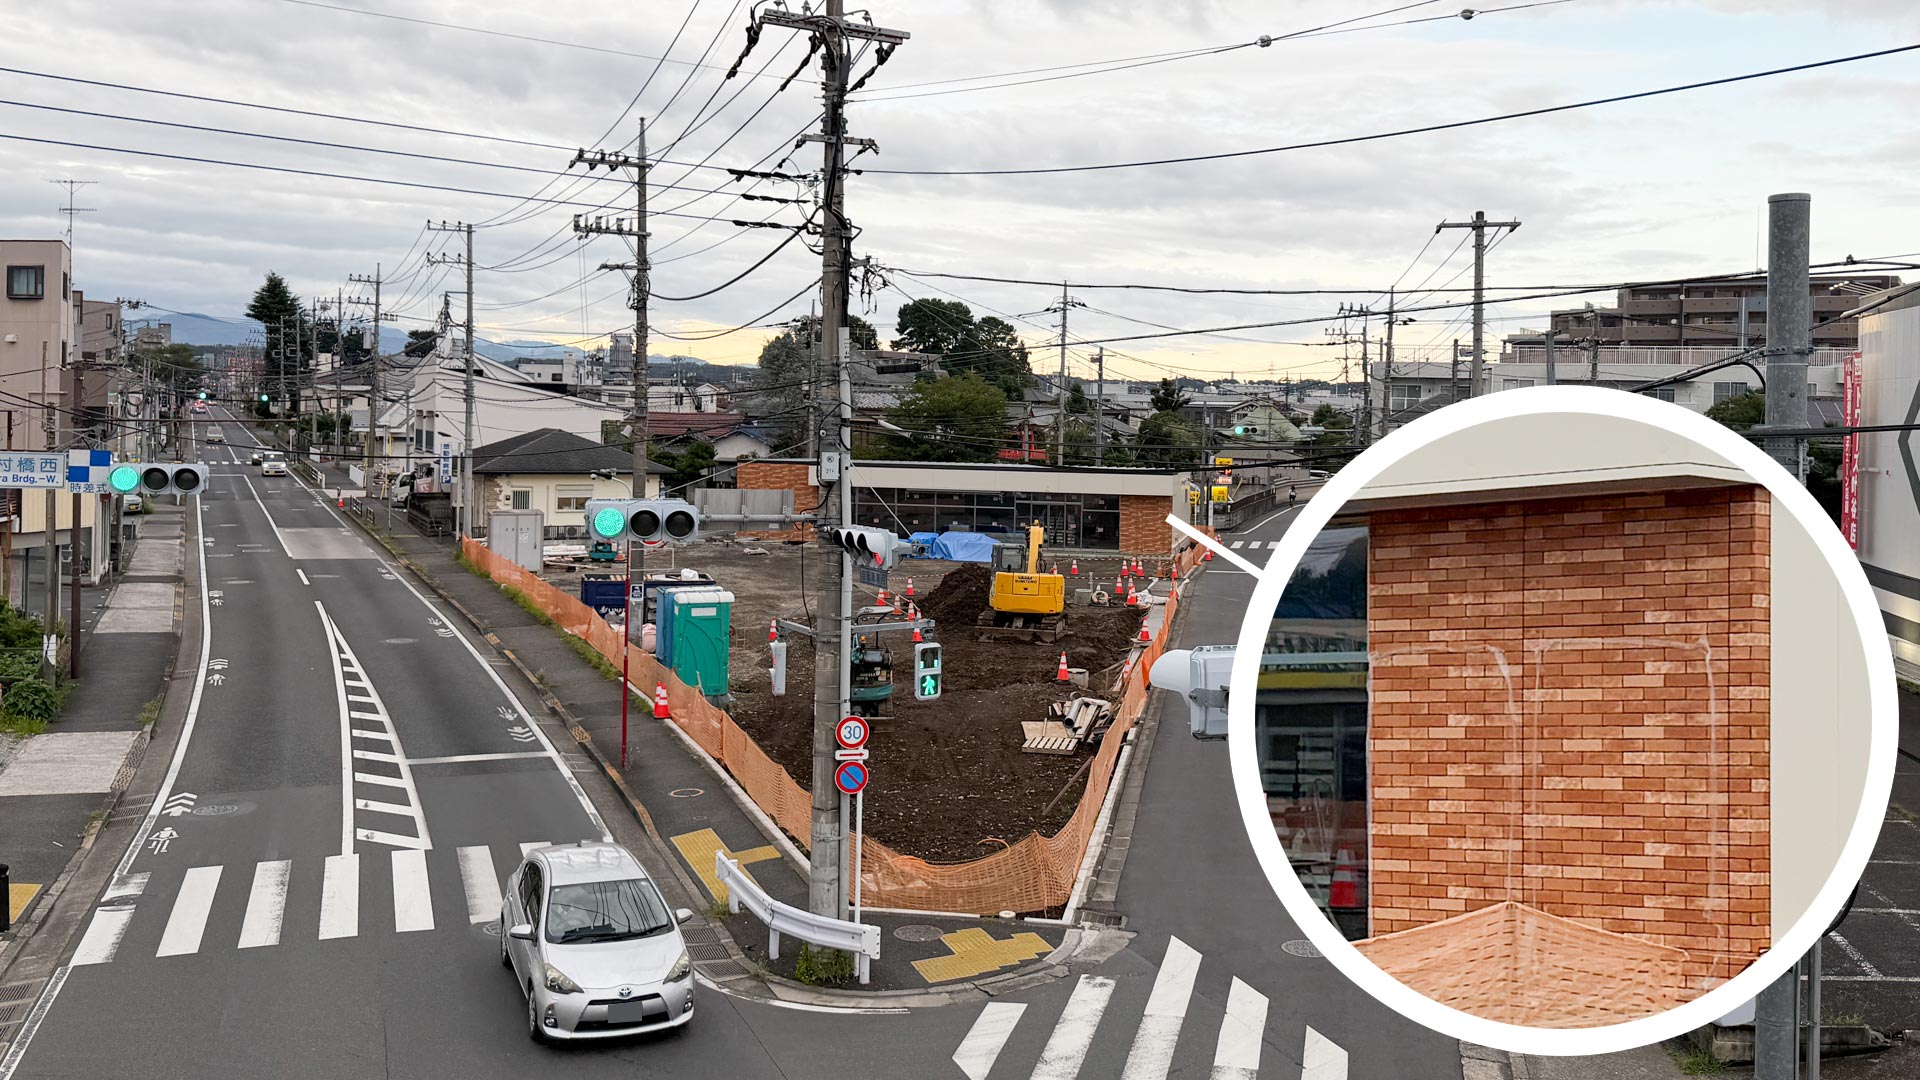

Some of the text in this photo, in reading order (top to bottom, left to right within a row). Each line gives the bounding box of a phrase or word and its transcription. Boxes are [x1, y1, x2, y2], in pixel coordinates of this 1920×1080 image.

[70, 482, 108, 493] 時差式
[843, 725, 862, 740] 30
